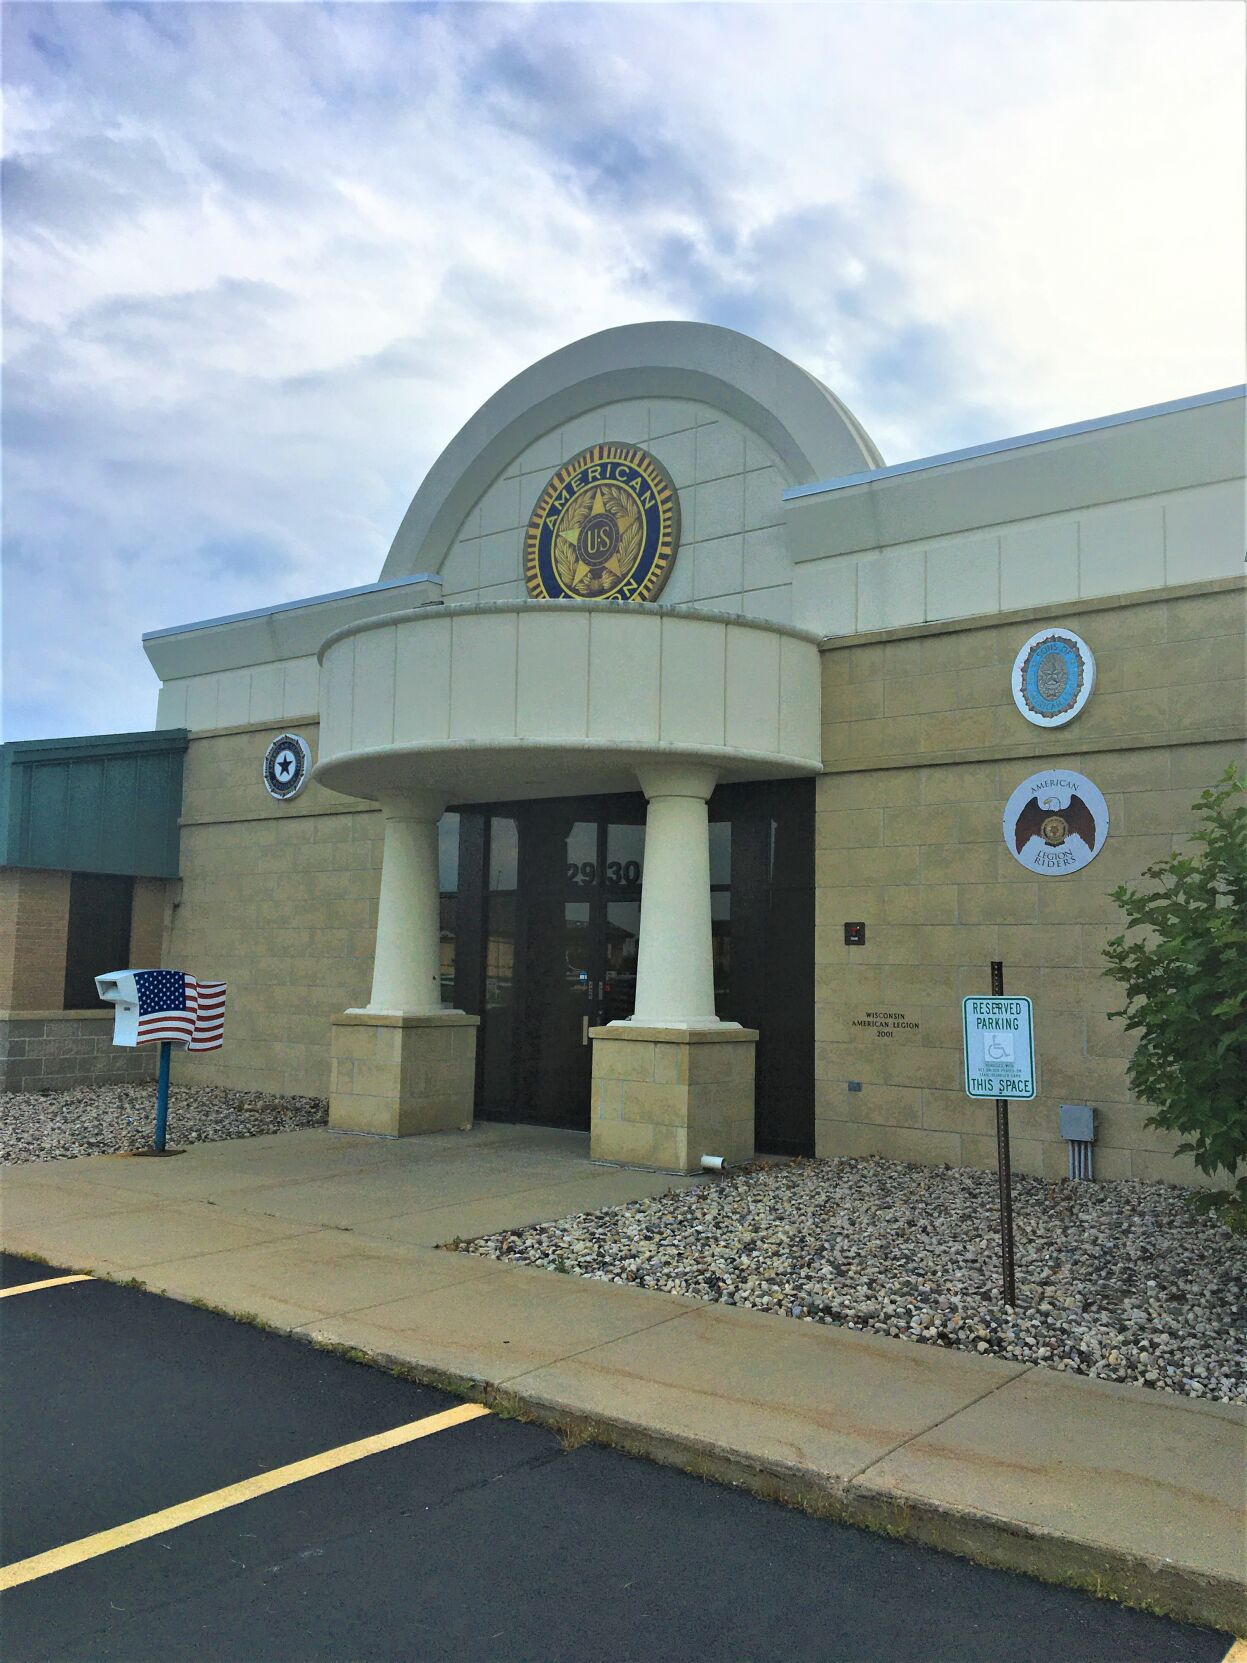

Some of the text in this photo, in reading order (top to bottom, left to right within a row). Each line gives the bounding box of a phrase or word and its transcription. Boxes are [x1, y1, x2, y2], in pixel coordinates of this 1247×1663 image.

[546, 463, 656, 531] AMERICAN
[1030, 779, 1080, 794] AMERICAN
[1037, 848, 1073, 861] LEGION
[1034, 857, 1077, 868] RIDERS
[973, 1002, 1021, 1015] RESERVED
[865, 1012, 905, 1020] WISCONSIN
[851, 1020, 889, 1028] AMERICAN
[976, 1017, 1019, 1031] PARKING
[877, 1030, 893, 1038] 2001
[971, 1078, 1030, 1093] THIS SPACE
